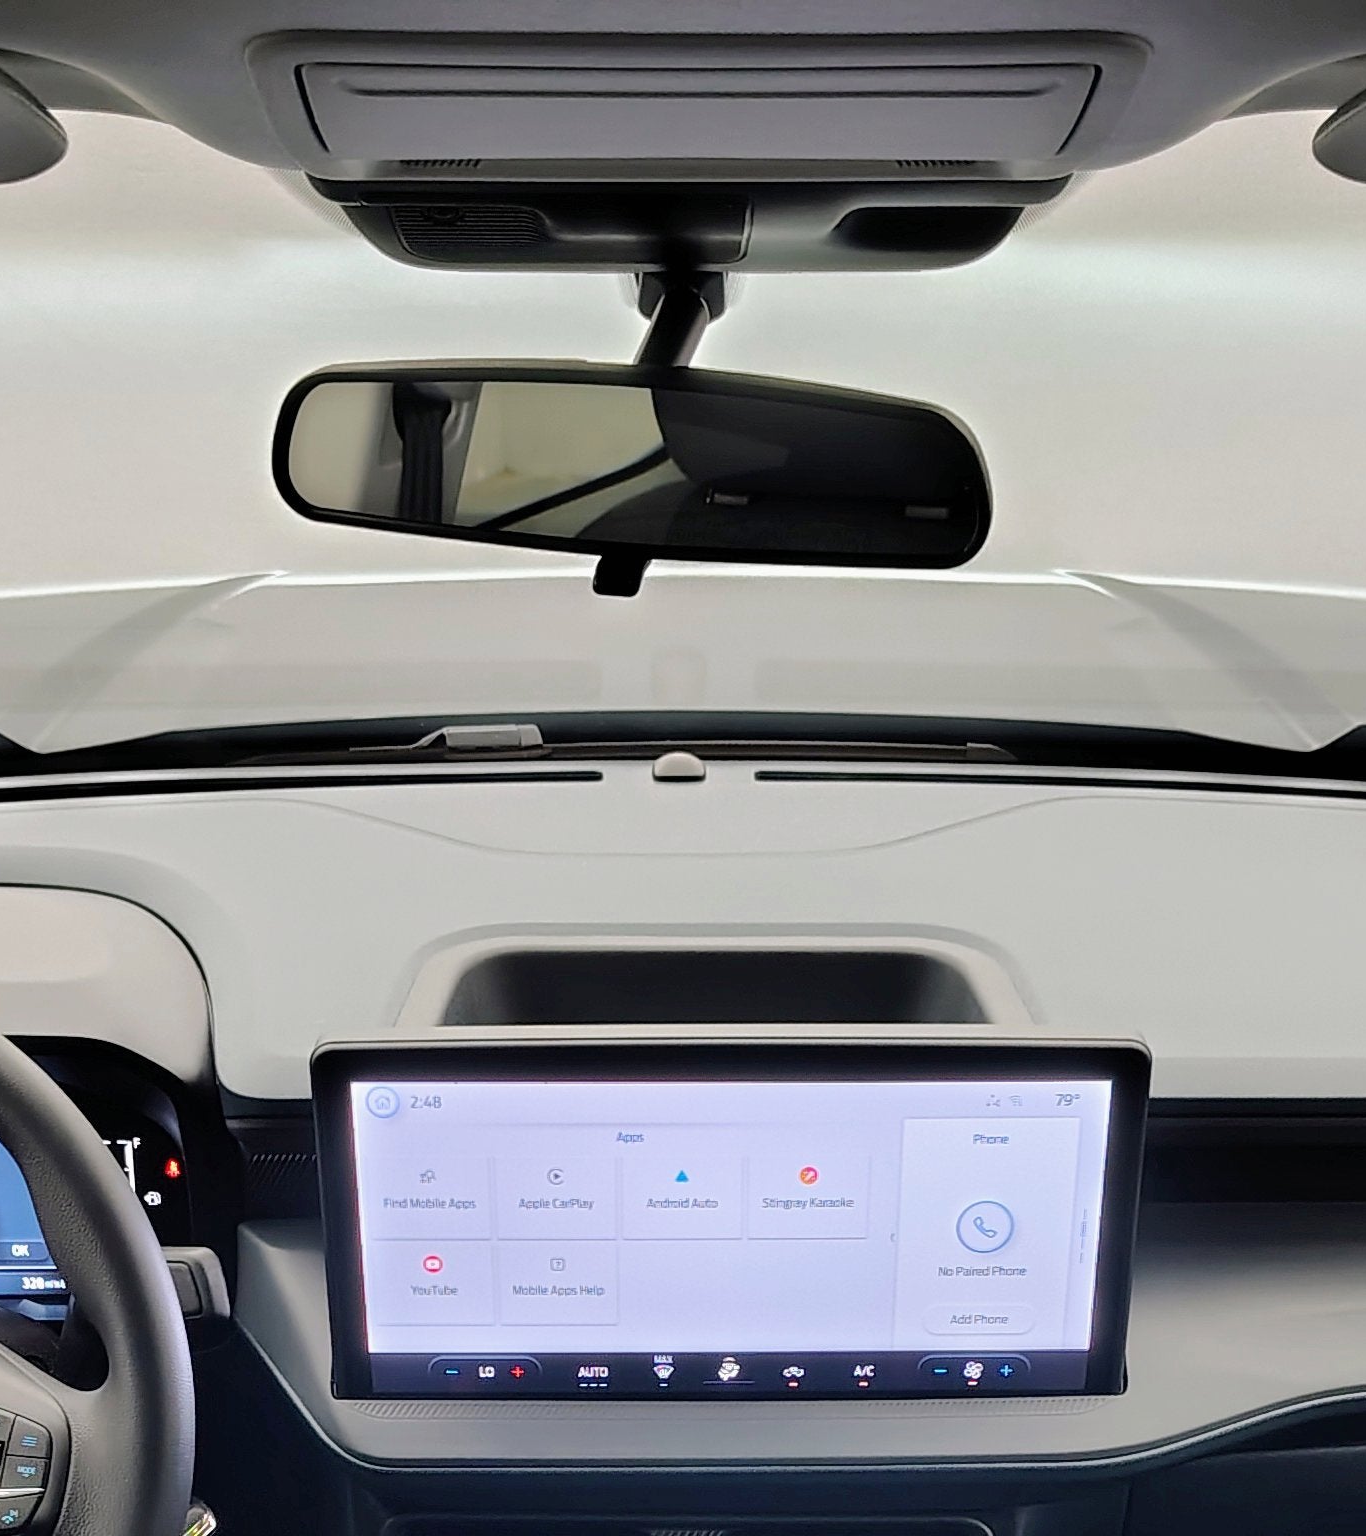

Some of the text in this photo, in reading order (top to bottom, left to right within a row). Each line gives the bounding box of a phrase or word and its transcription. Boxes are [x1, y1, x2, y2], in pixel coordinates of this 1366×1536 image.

[410, 1095, 443, 1109] 2:48
[616, 1131, 645, 1143] Apps
[972, 1133, 1010, 1145] Phone
[383, 1197, 477, 1210] Find Mobile Apps
[518, 1198, 595, 1211] Apple CarPlay
[646, 1197, 719, 1209] Android Auto
[762, 1197, 855, 1210] Stingray Karaoke
[12, 1244, 30, 1257] OK
[938, 1265, 1028, 1277] No Paired Phone
[410, 1285, 459, 1297] YouTube
[512, 1285, 606, 1297] Mobile Apps Help
[949, 1314, 1010, 1325] Add Phone
[478, 1366, 496, 1378] LO
[577, 1366, 610, 1378] AUTO
[853, 1364, 875, 1377] A/C
